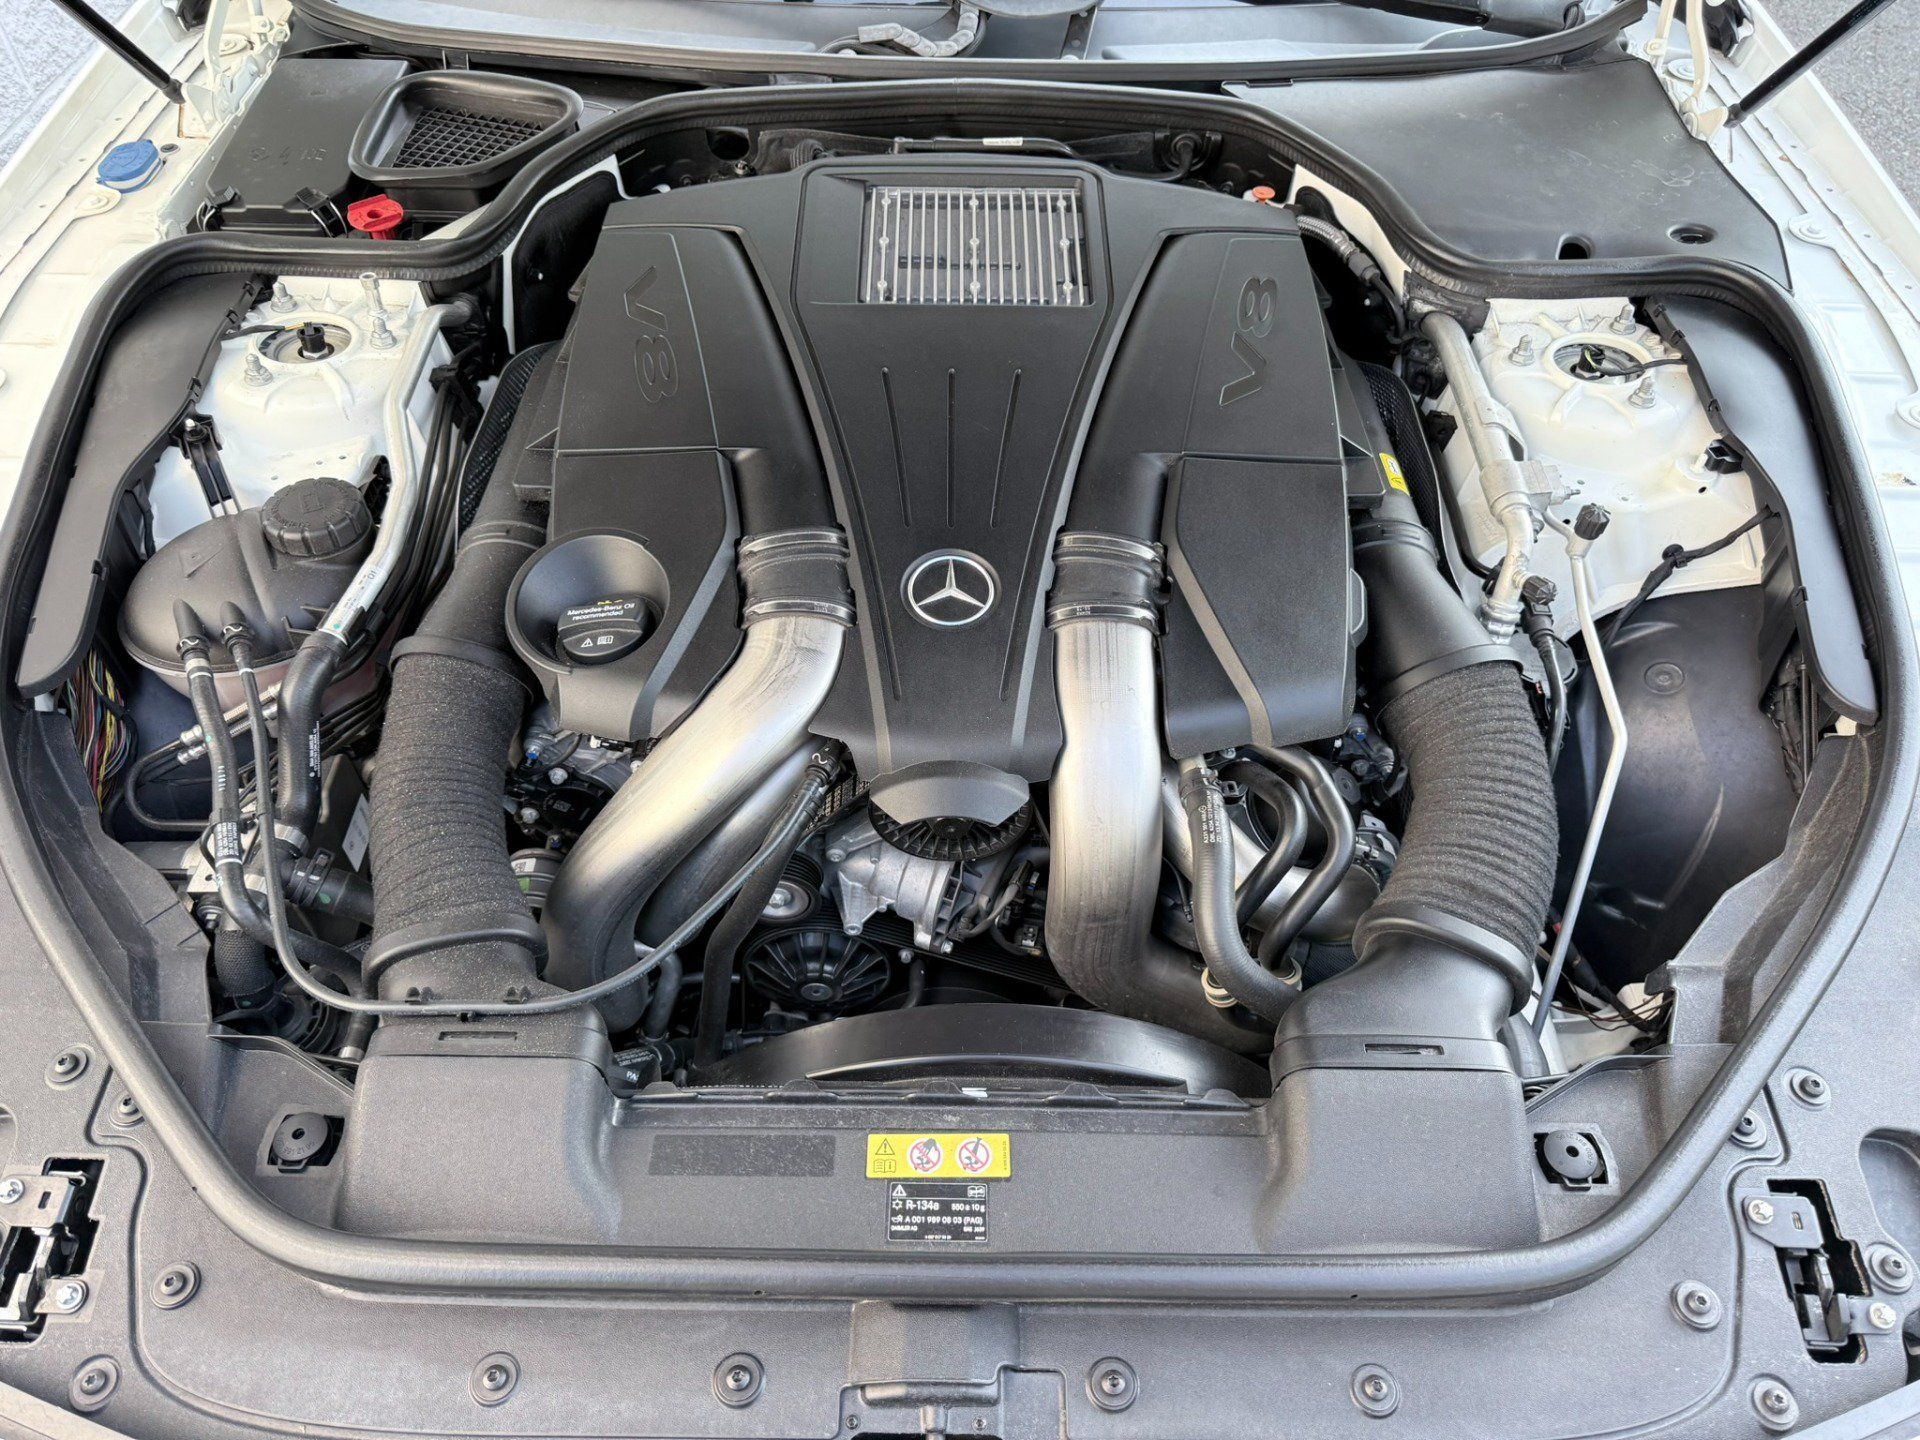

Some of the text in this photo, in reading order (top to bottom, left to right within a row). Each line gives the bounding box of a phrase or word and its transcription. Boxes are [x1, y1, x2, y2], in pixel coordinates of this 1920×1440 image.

[624, 265, 679, 403] V8
[1219, 277, 1277, 407] V8
[567, 605, 622, 615] Mercedes-Benz
[572, 610, 623, 620] recommended
[905, 1200, 939, 1211] R-134a
[972, 1203, 980, 1211] 10
[953, 1216, 963, 1224] 03
[963, 1216, 983, 1225] (PAG)
